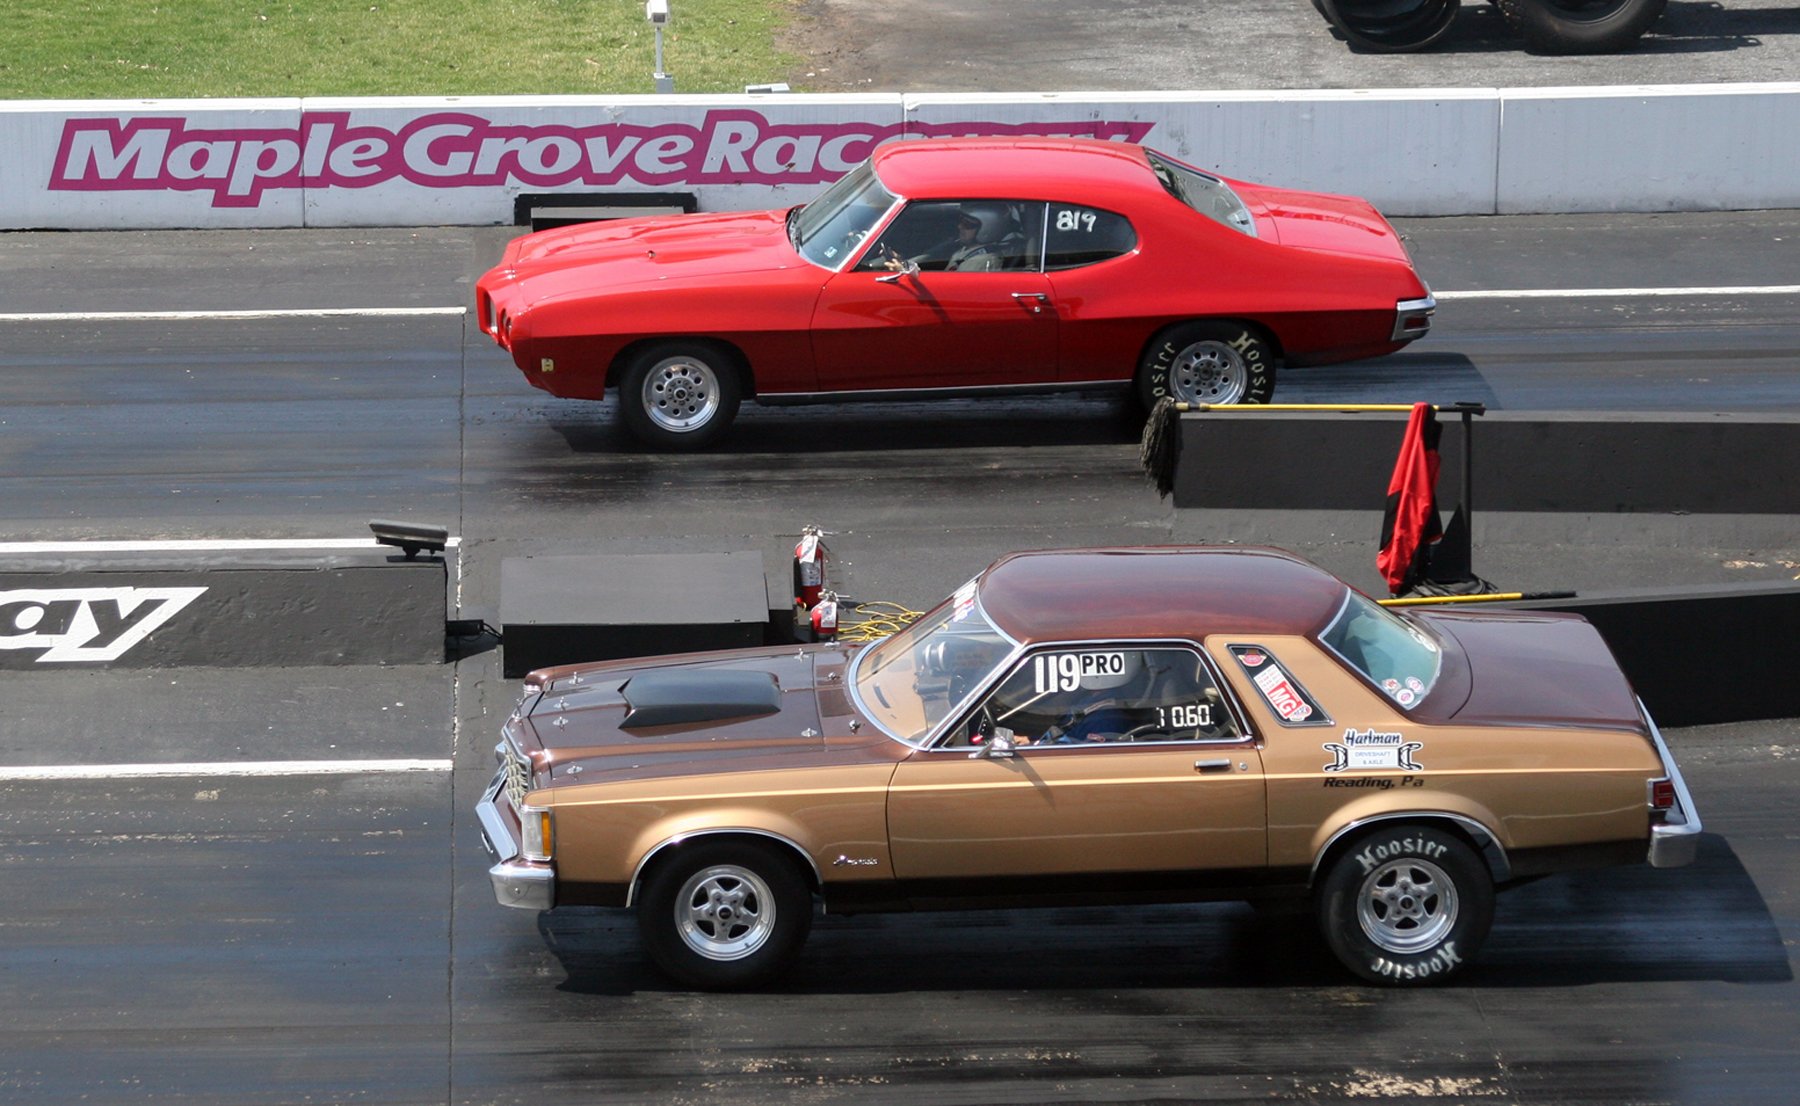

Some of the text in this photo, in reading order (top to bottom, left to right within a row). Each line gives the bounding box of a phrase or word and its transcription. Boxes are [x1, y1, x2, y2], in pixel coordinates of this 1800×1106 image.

[1055, 210, 1097, 233] 819
[1034, 653, 1124, 693] 119 PRO
[1344, 729, 1400, 746] Hartman
[1323, 775, 1425, 790] Reading, Pa
[1355, 832, 1448, 876] Hoosier
[1371, 941, 1463, 983] Hoosier
